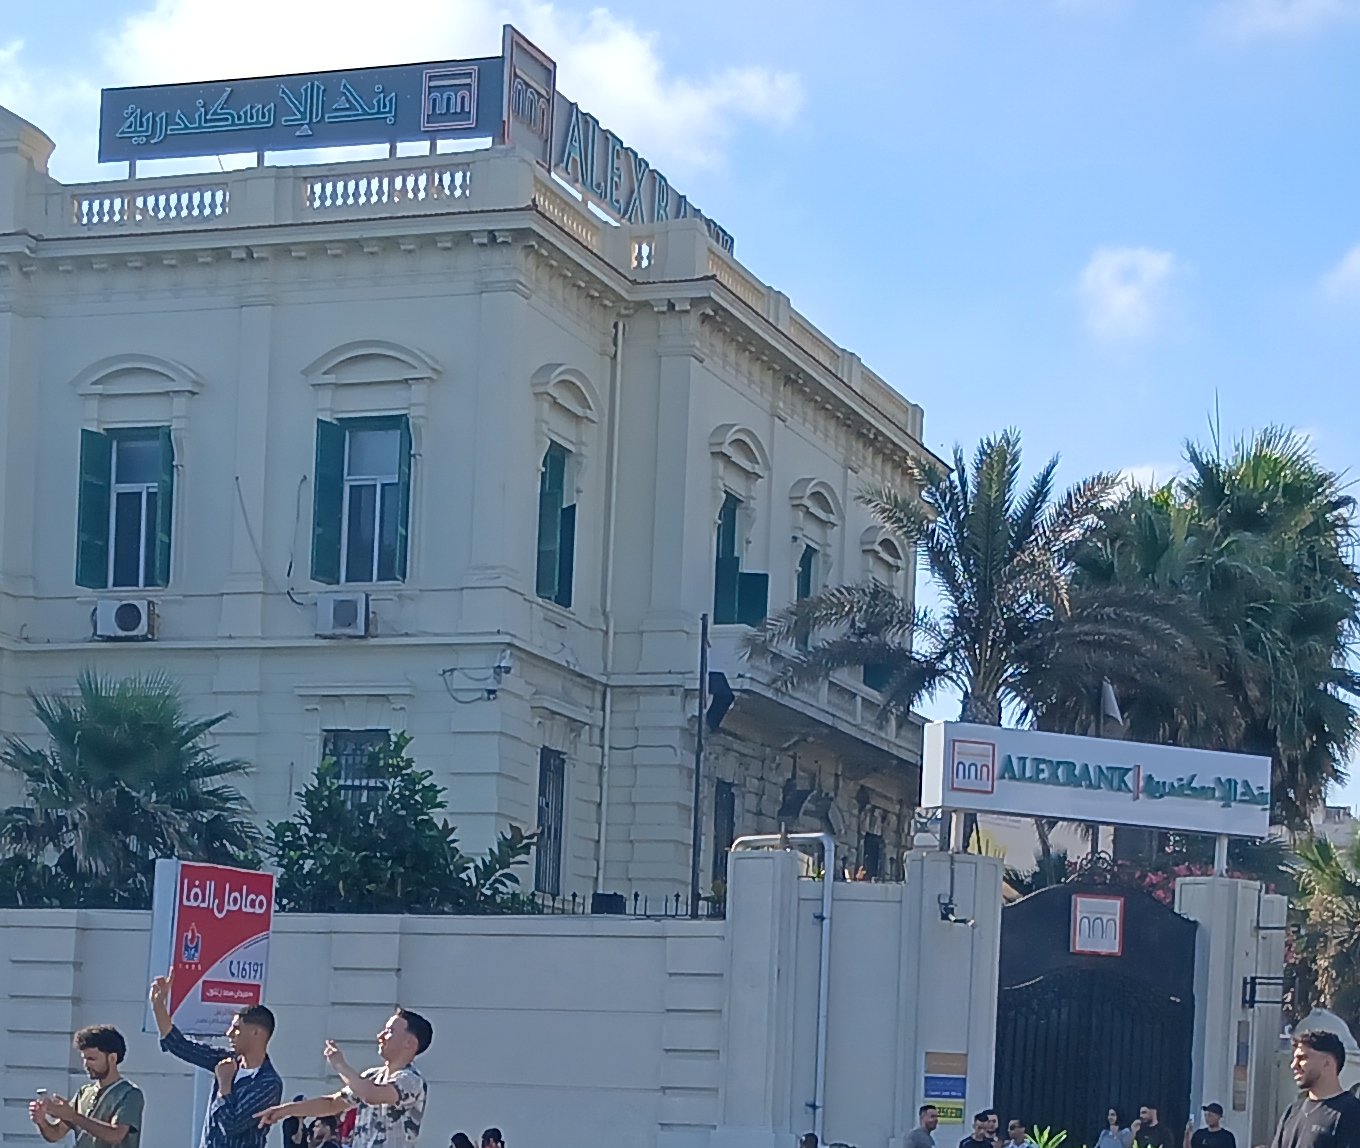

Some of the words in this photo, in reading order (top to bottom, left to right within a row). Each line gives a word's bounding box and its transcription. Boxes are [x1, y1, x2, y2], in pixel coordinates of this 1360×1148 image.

[325, 79, 396, 125] بنك
[996, 754, 1132, 793] ALEXBANK
[213, 882, 267, 919] معامل
[237, 960, 263, 980] 16191
